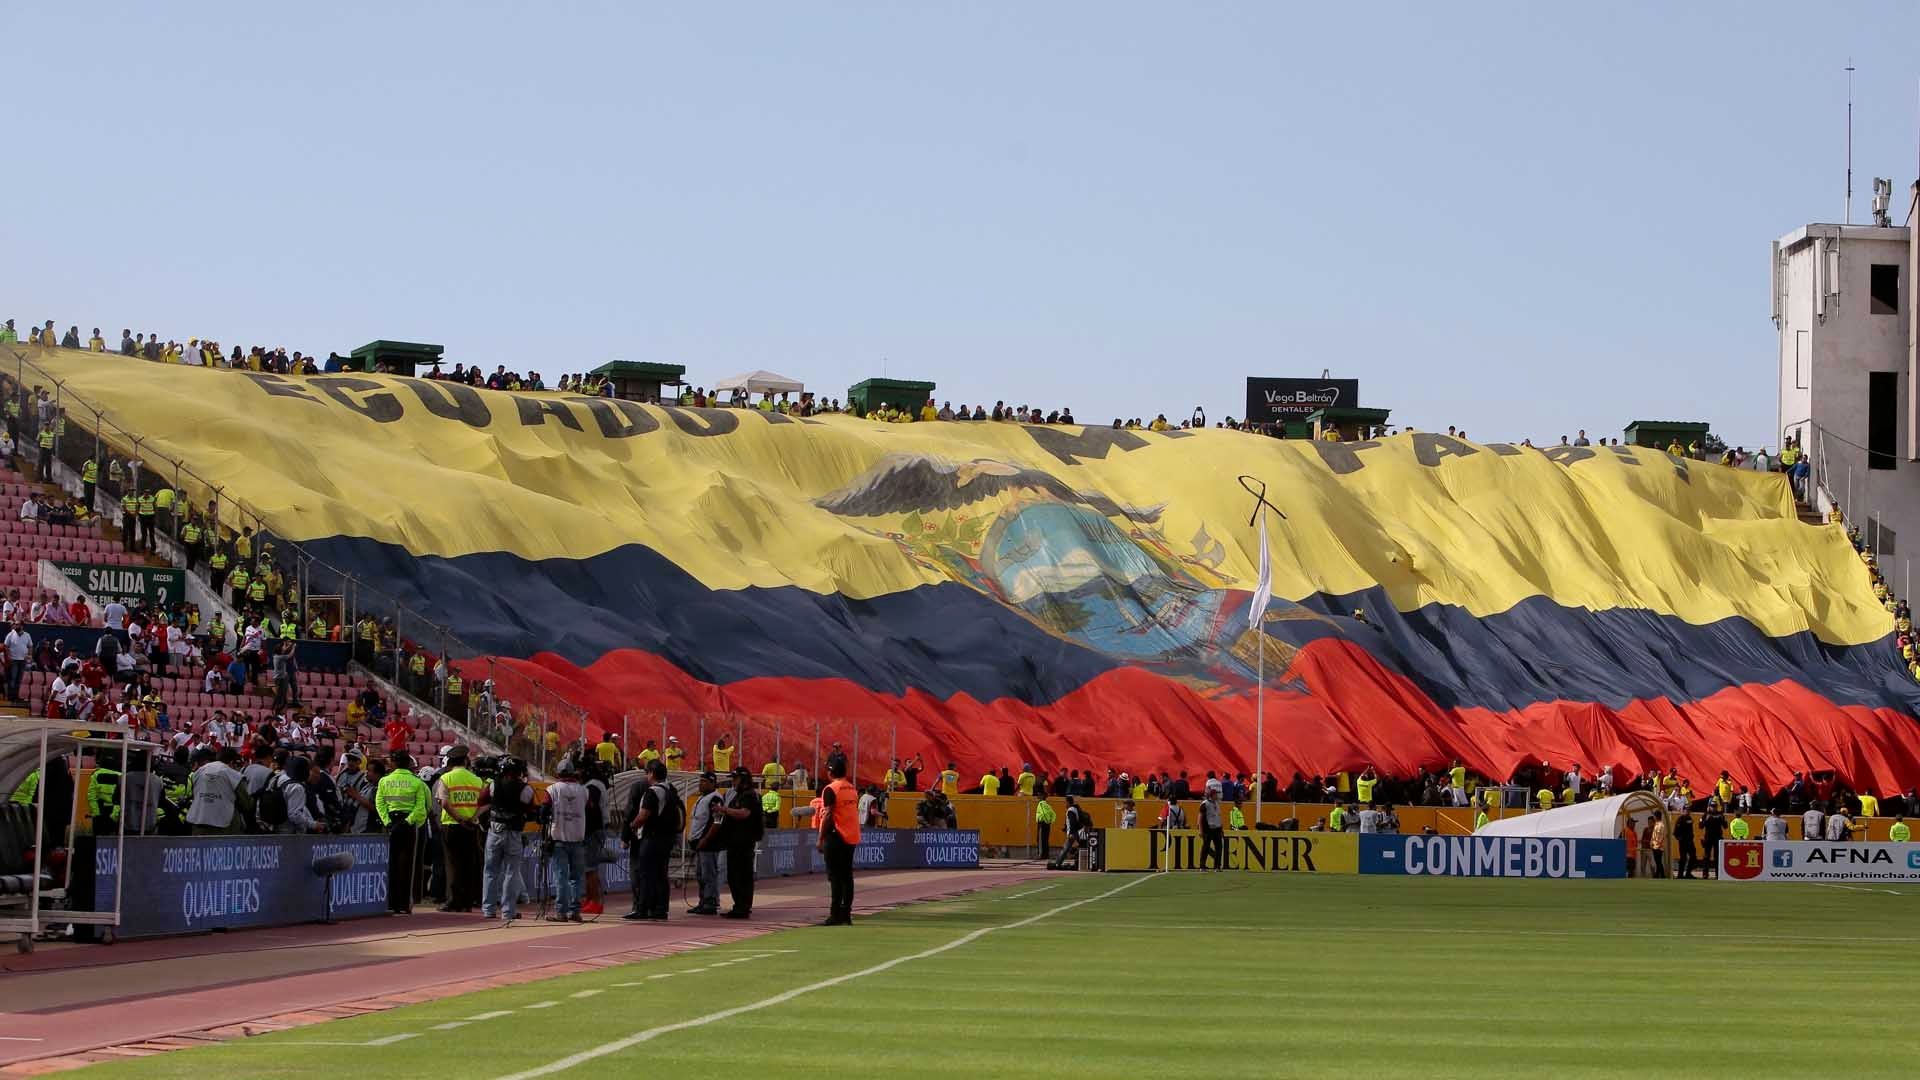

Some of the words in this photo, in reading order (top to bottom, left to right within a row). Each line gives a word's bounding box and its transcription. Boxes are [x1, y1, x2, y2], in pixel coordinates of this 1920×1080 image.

[241, 372, 826, 438] ECUADO
[62, 567, 82, 576] ACCESO
[88, 569, 145, 594] SALIDA
[152, 573, 173, 582] ACCESO
[938, 833, 960, 843] WORLD
[960, 833, 971, 843] CUP
[162, 847, 183, 873] 2018
[184, 847, 201, 873] FIFA
[203, 847, 233, 872] WORLD
[235, 846, 252, 871] CUP
[252, 845, 279, 869] RUSSIA
[369, 843, 382, 865] CUP
[926, 846, 978, 865] QUALIFIERS
[1148, 830, 1317, 872] PILENER
[1404, 835, 1586, 878] CONMEBOL
[1806, 848, 1893, 864] AFNA
[183, 877, 260, 926] QUALIFIERS
